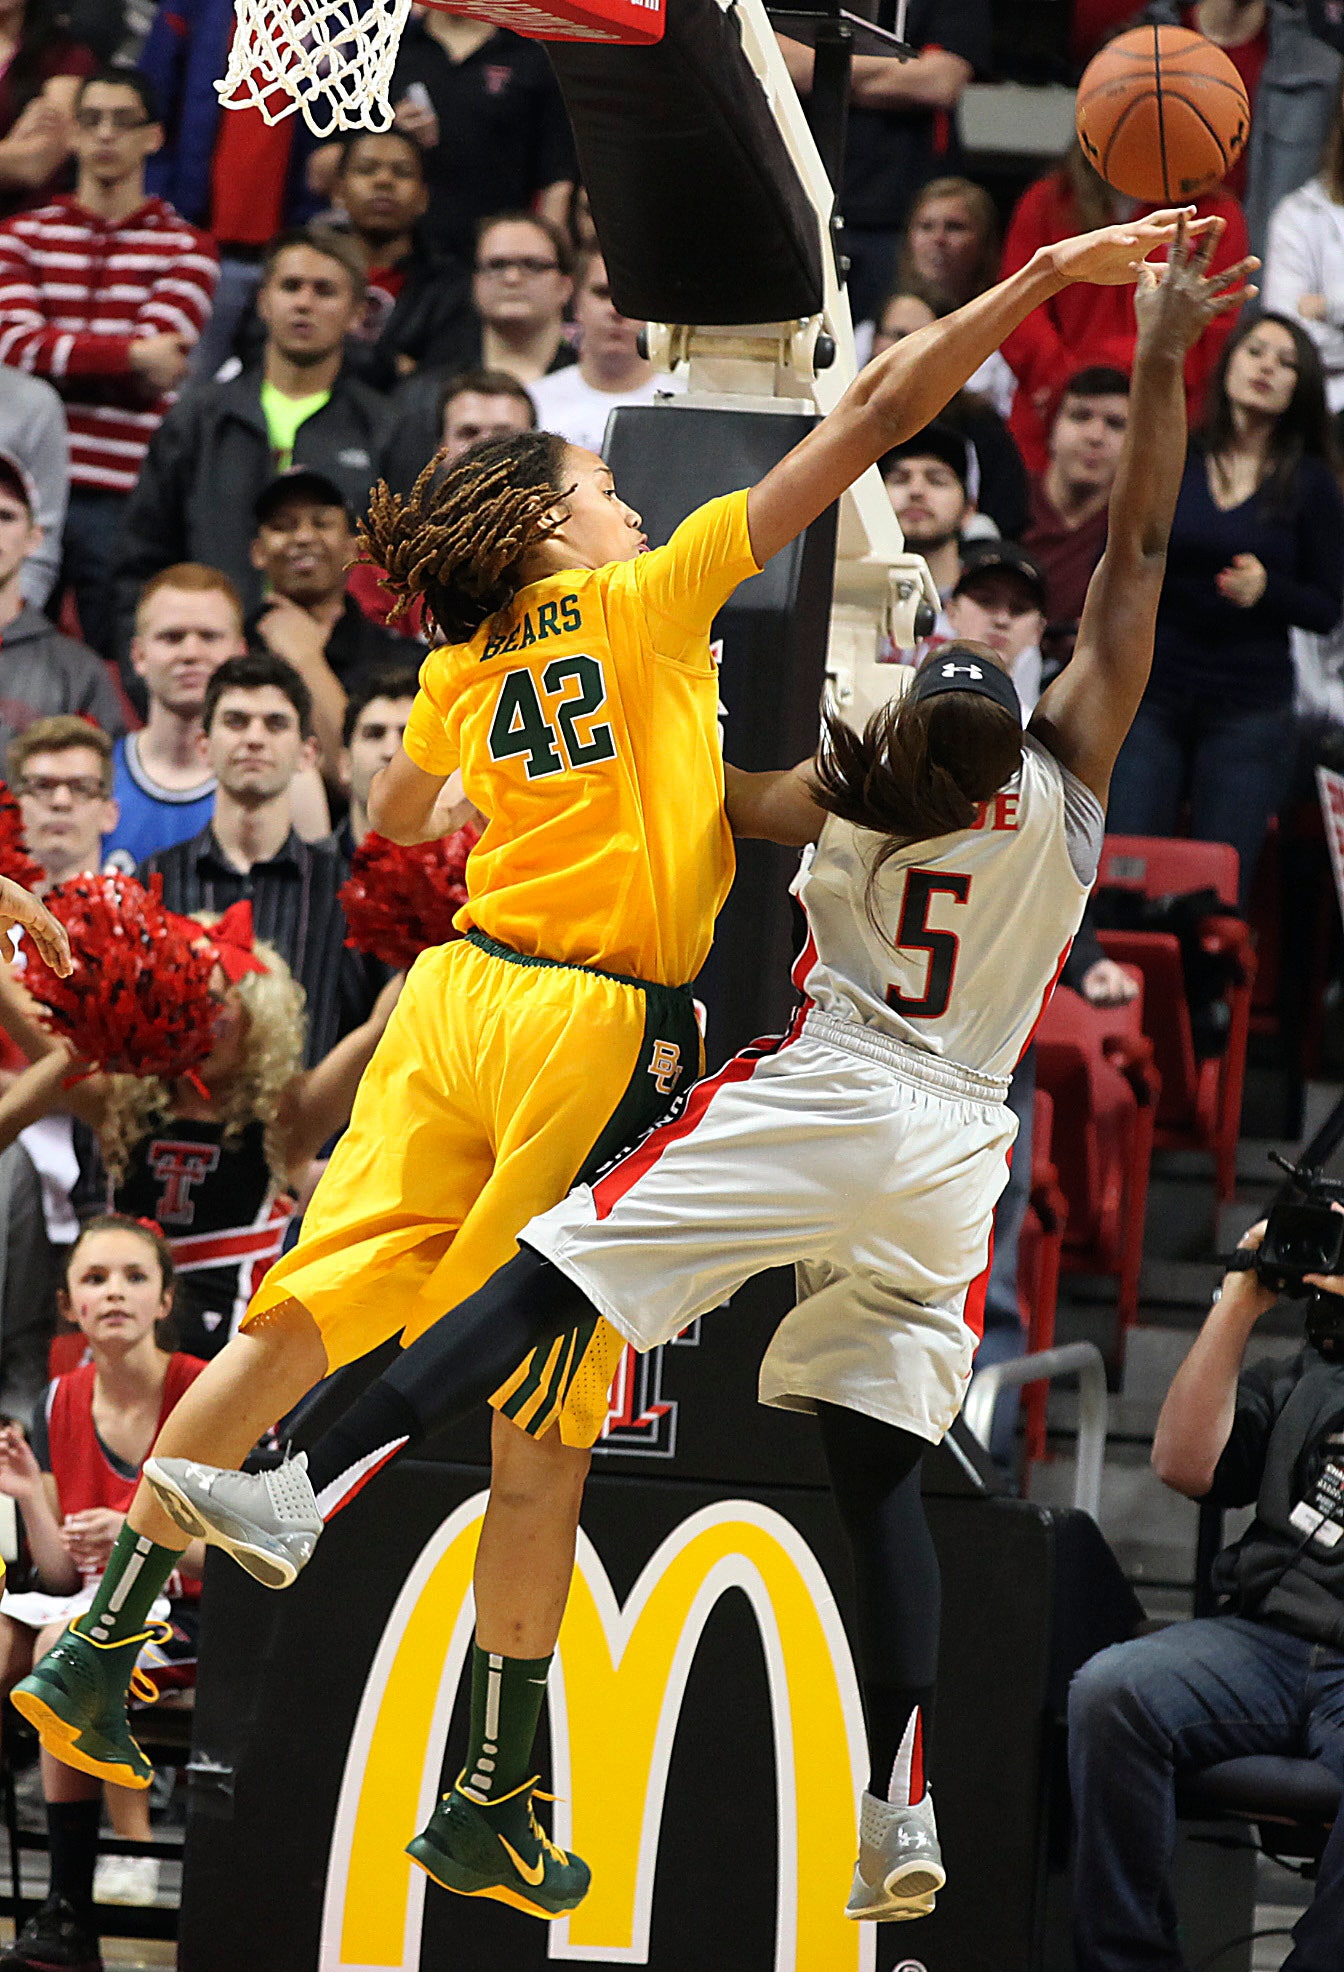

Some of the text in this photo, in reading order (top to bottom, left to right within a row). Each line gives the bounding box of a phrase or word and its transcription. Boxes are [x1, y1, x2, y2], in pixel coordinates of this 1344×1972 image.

[479, 593, 582, 662] BEARS
[487, 653, 617, 781] 42
[886, 867, 972, 1019] 5
